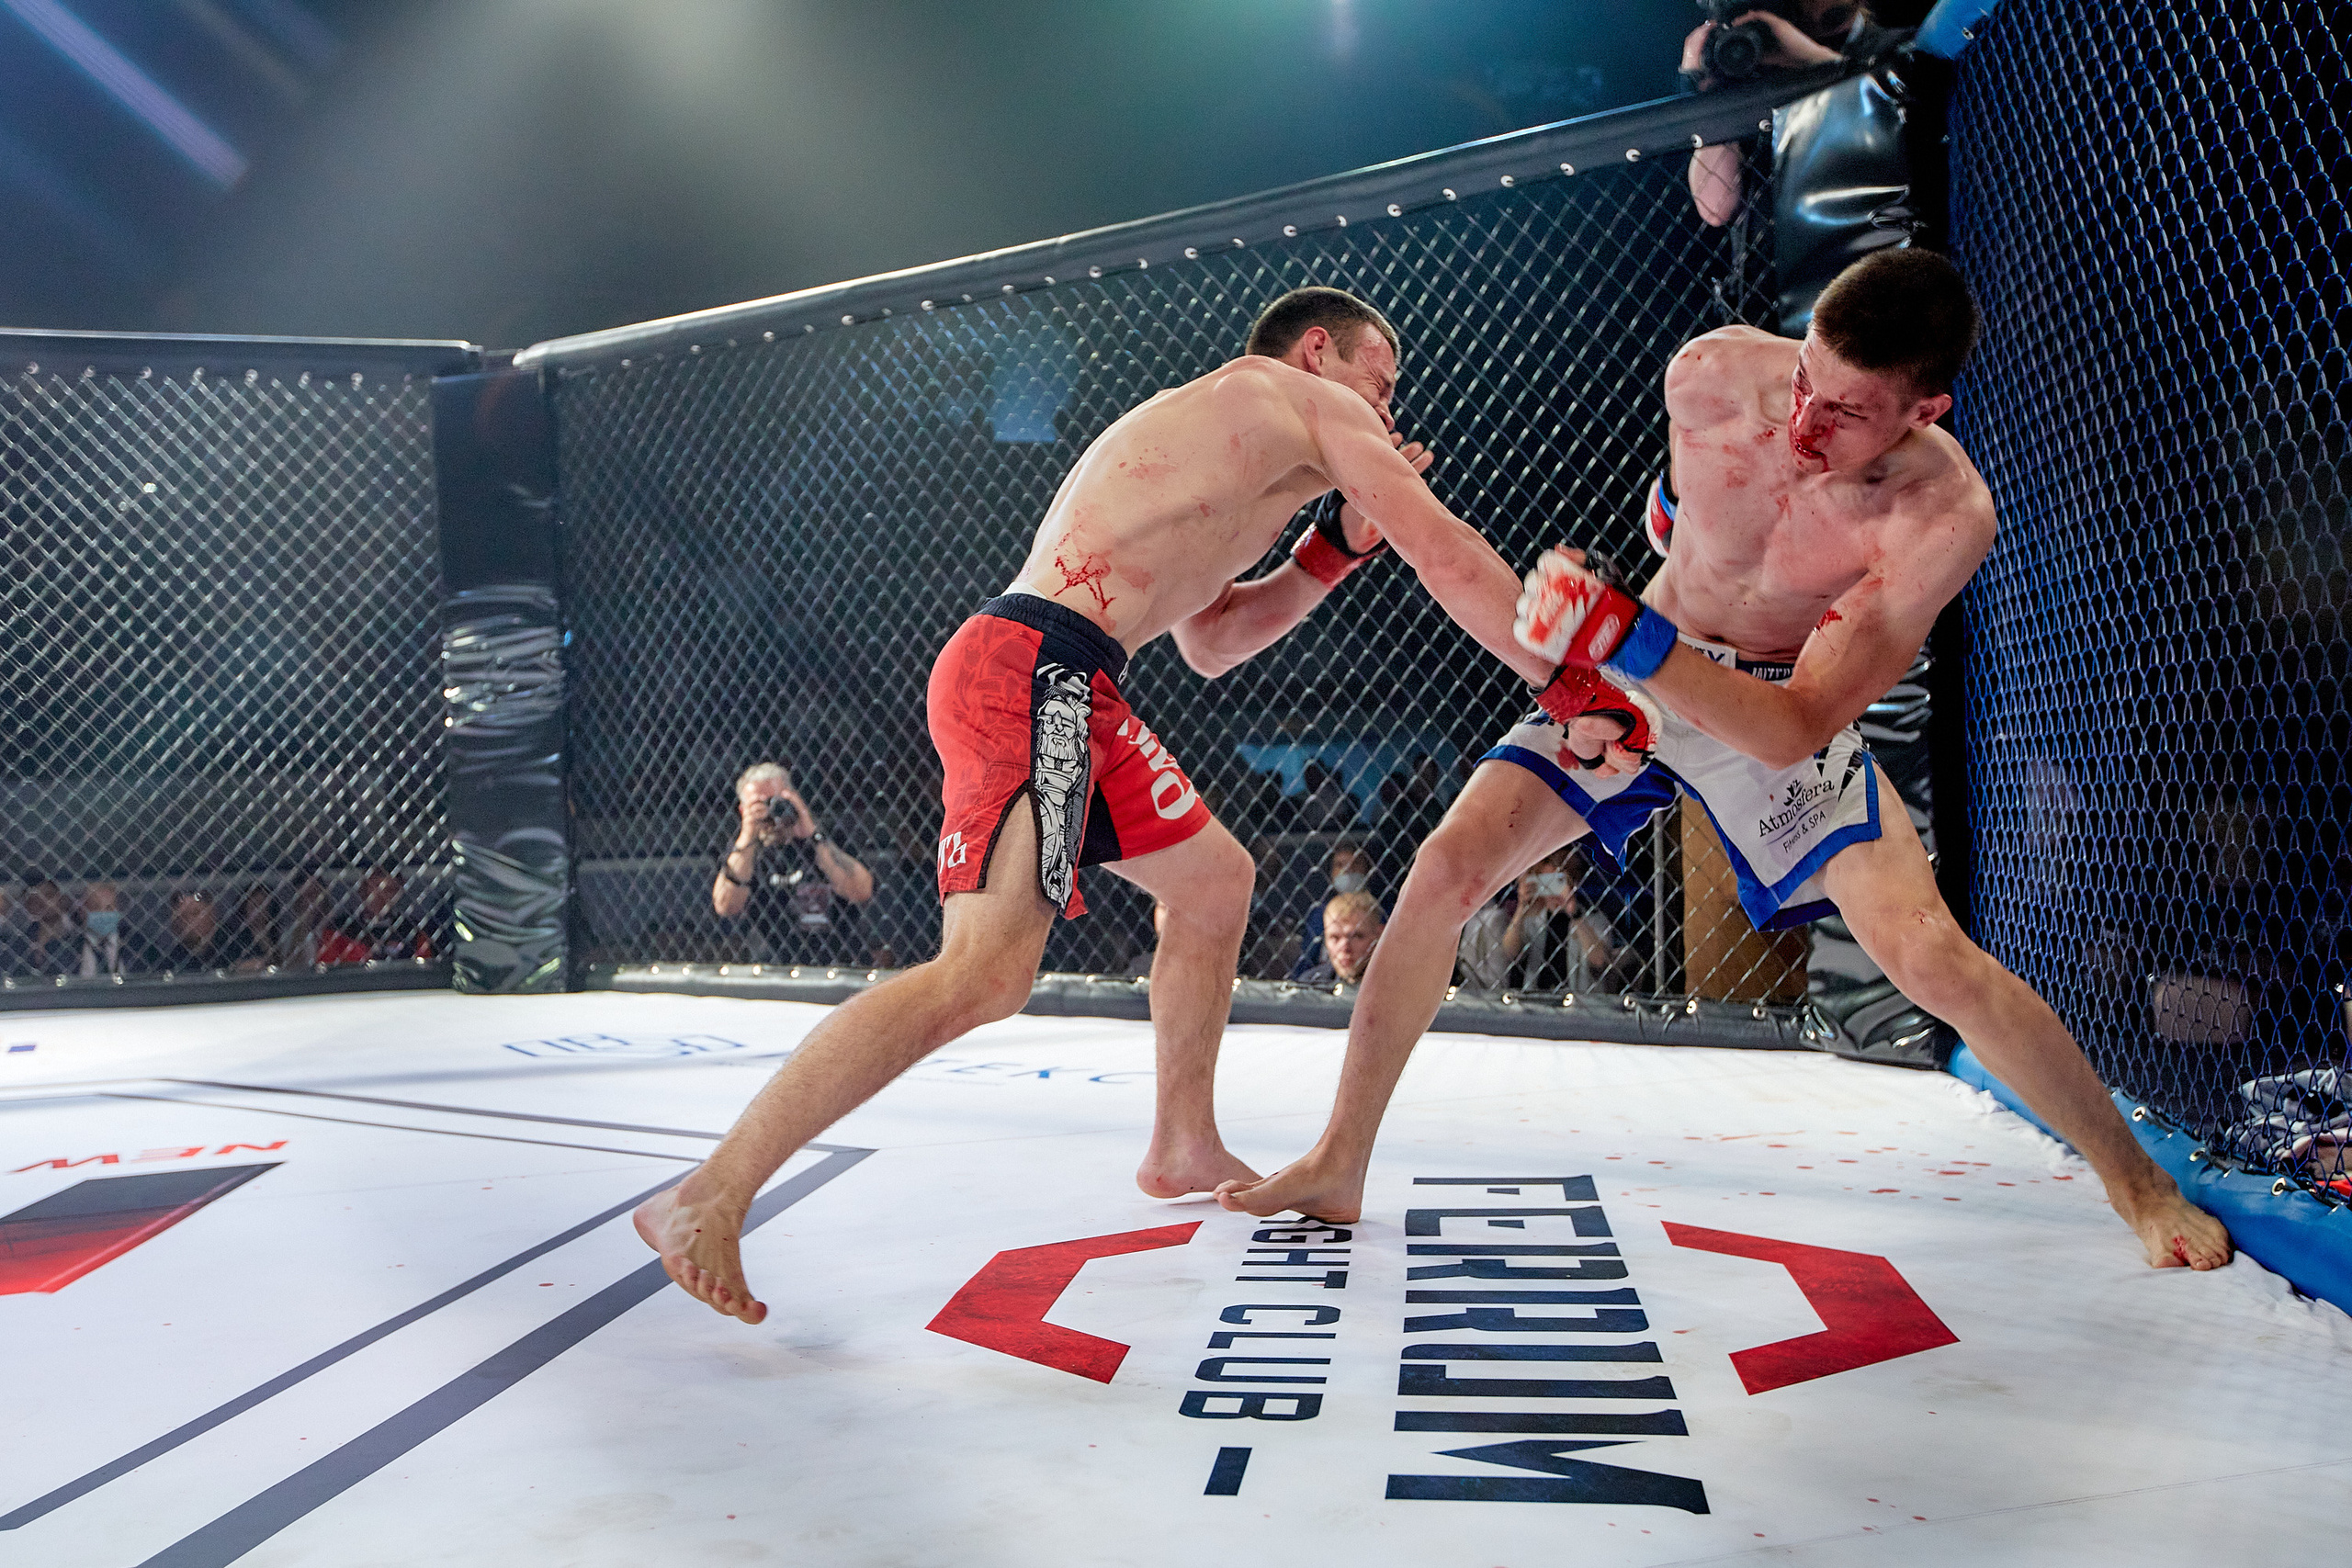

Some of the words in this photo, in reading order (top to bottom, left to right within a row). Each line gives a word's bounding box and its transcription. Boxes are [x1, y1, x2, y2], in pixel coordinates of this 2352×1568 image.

[1758, 778, 1835, 837] Atmosfera
[1801, 823, 1810, 834] &
[1810, 810, 1827, 829] SPA
[1236, 1215, 1352, 1289] IGHT
[1179, 1304, 1340, 1421] CLUB
[1385, 1175, 1711, 1515] FERRUM
